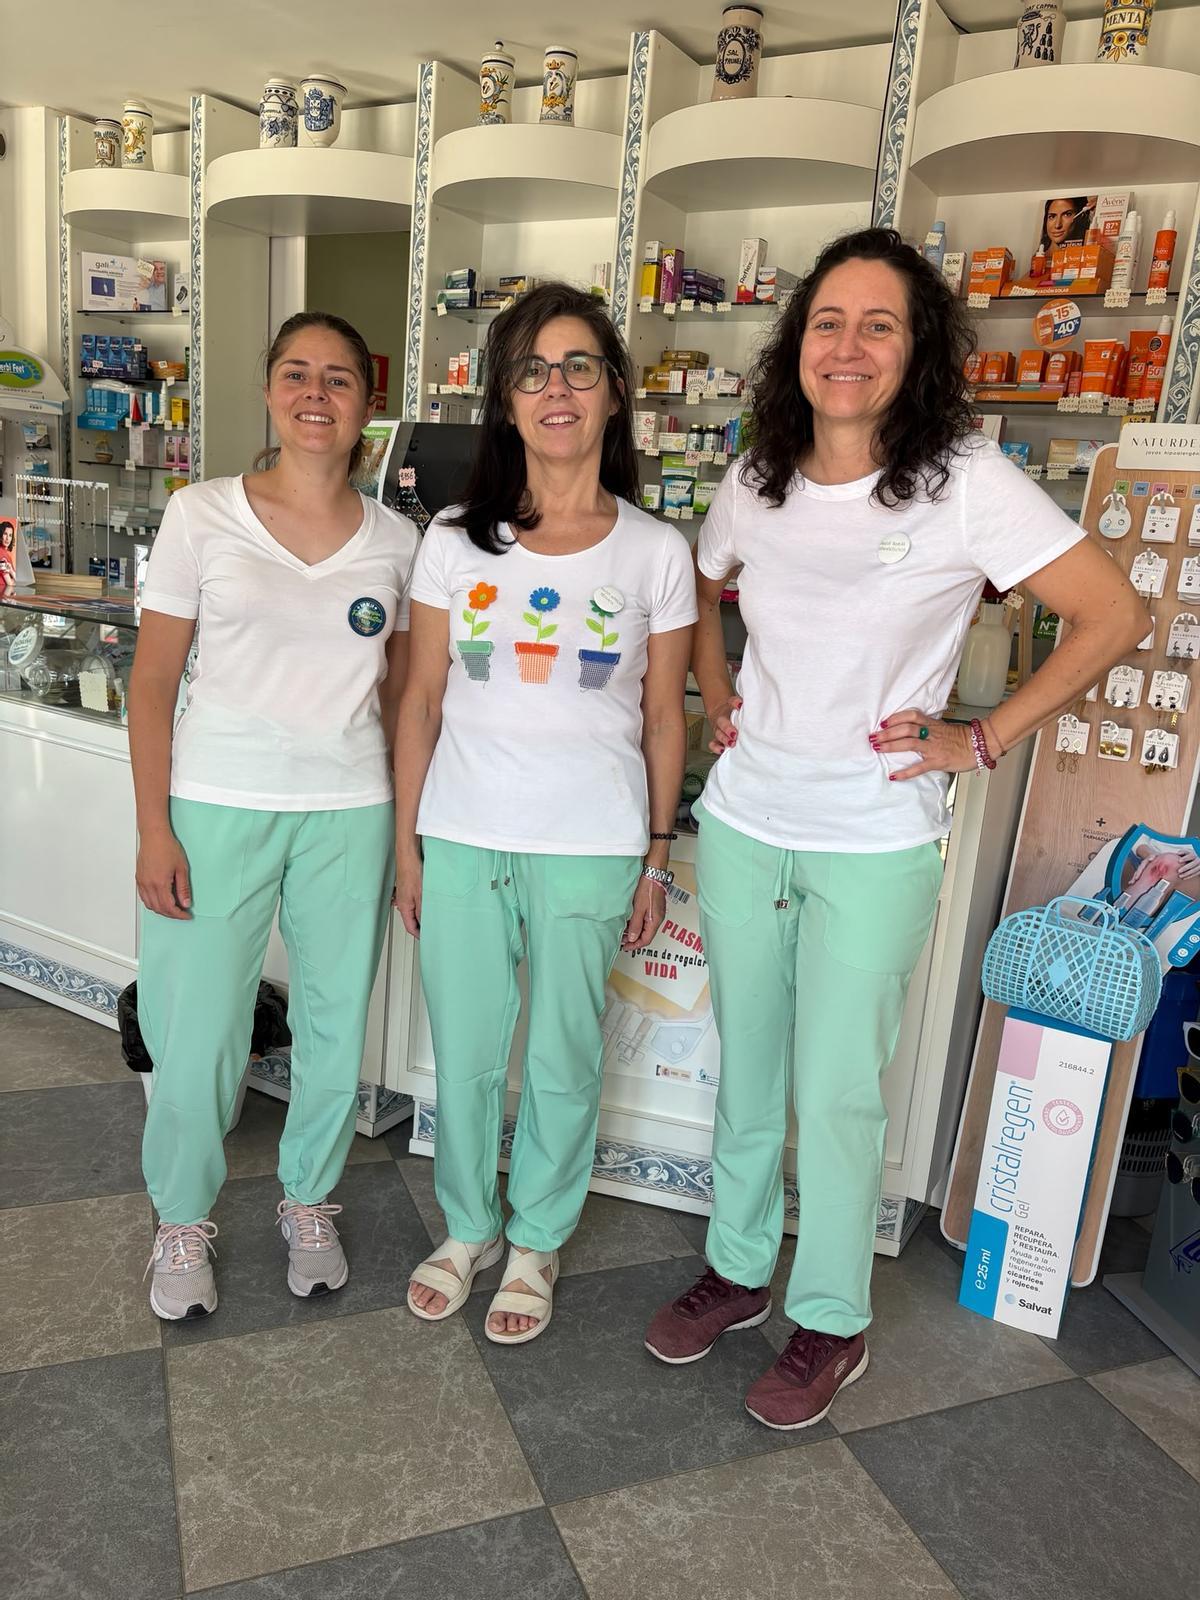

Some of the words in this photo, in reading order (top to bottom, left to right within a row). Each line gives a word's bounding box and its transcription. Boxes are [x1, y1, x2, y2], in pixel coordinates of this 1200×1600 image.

[1104, 11, 1142, 27] MENTA
[726, 49, 739, 57] SAL
[1101, 197, 1126, 206] Avène
[12, 364, 25, 373] Feet
[82, 366, 99, 376] durex
[1131, 437, 1200, 448] NATURDE
[661, 919, 706, 955] PLASM
[661, 947, 672, 961] de
[674, 952, 708, 969] regalar
[644, 960, 678, 980] VIDA
[1058, 1061, 1095, 1075] 216844.2
[987, 1084, 1035, 1213] cristalregen
[1014, 1199, 1031, 1219] Gel
[1013, 1232, 1053, 1249] RECUPERA
[1010, 1247, 1033, 1261] Ayuda
[1041, 1256, 1049, 1264] la
[1019, 1242, 1060, 1259] RESTAURA.
[1008, 1262, 1032, 1275] tisular
[1033, 1270, 1043, 1278] de
[1009, 1255, 1057, 1274] regeneración
[1007, 1269, 1044, 1286] cicatrices
[1011, 1279, 1041, 1292] rojeces.
[1018, 1298, 1053, 1316] Salvat
